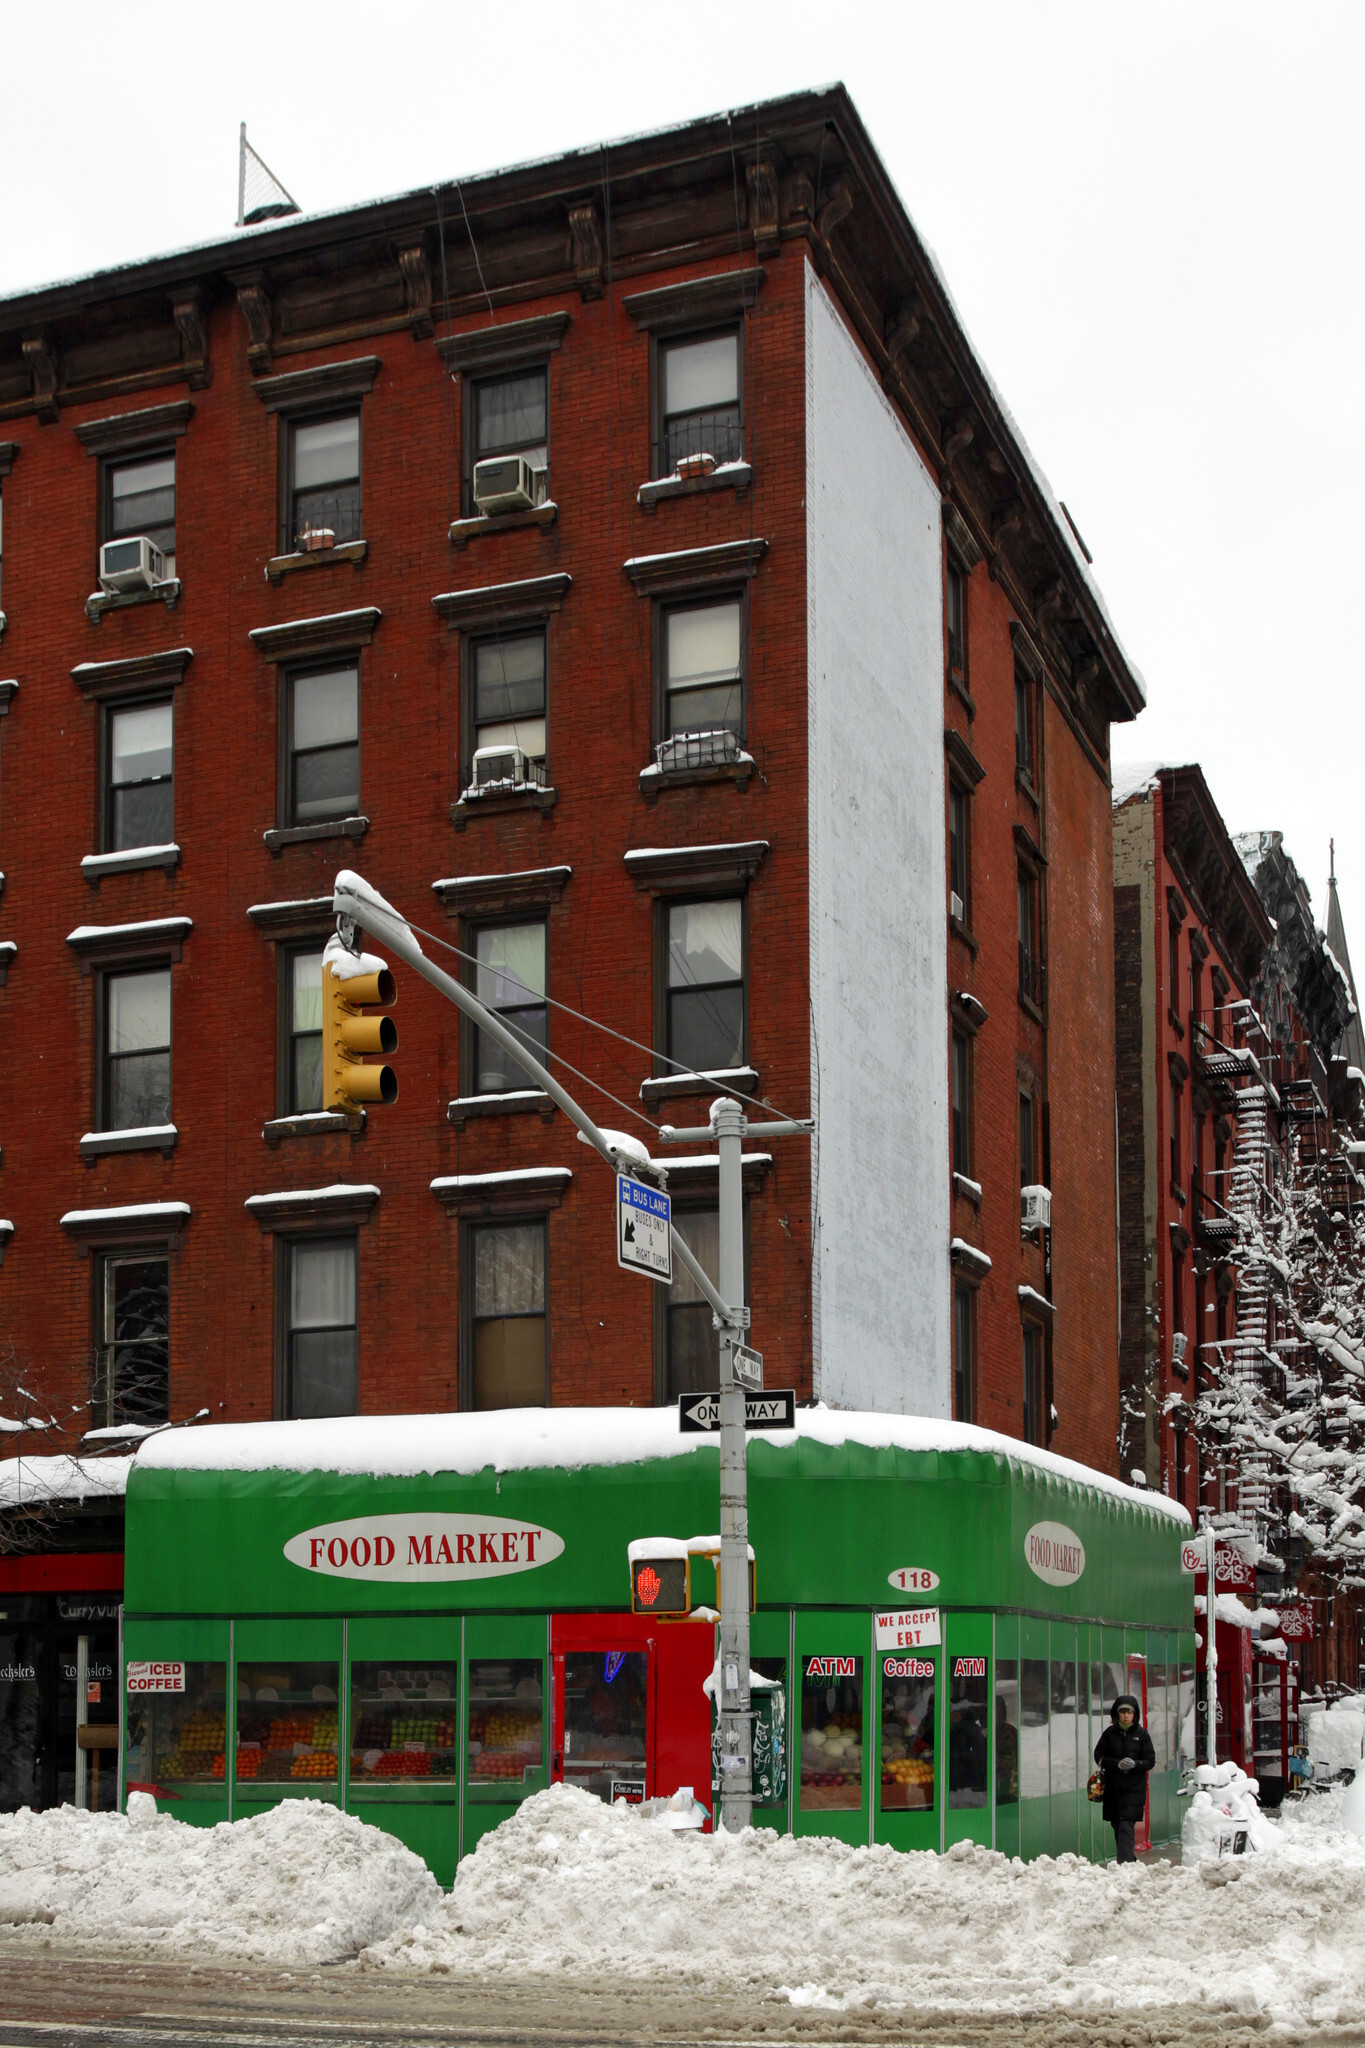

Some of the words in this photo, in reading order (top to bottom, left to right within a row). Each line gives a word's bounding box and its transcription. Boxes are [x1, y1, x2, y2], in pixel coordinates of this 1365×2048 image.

[633, 1189, 648, 1206] BUS
[649, 1195, 667, 1215] LANE
[635, 1210, 652, 1228] BUSES
[653, 1217, 665, 1233] ONLY
[649, 1233, 653, 1246] &
[635, 1247, 650, 1263] RIGHT
[652, 1253, 668, 1270] TURNS
[737, 1356, 746, 1373] ONE
[749, 1361, 759, 1377] WAY
[697, 1405, 719, 1421] ON
[745, 1403, 779, 1418] WAY
[309, 1536, 395, 1568] FOOD
[407, 1530, 541, 1565] MARKET
[1030, 1534, 1051, 1568] FOOD
[1053, 1542, 1081, 1575] MARKET
[1214, 1549, 1243, 1566] ARA
[897, 1571, 932, 1589] 118
[1215, 1564, 1244, 1581] CAS
[878, 1616, 894, 1628] WE
[898, 1612, 937, 1626] ACCEPT
[1281, 1622, 1303, 1634] CAS
[897, 1630, 922, 1647] EBT
[150, 1663, 182, 1675] ICED
[806, 1657, 856, 1677] ATM
[883, 1658, 934, 1677] Coffee
[954, 1658, 986, 1677] ATM
[128, 1678, 182, 1690] COFFEE
